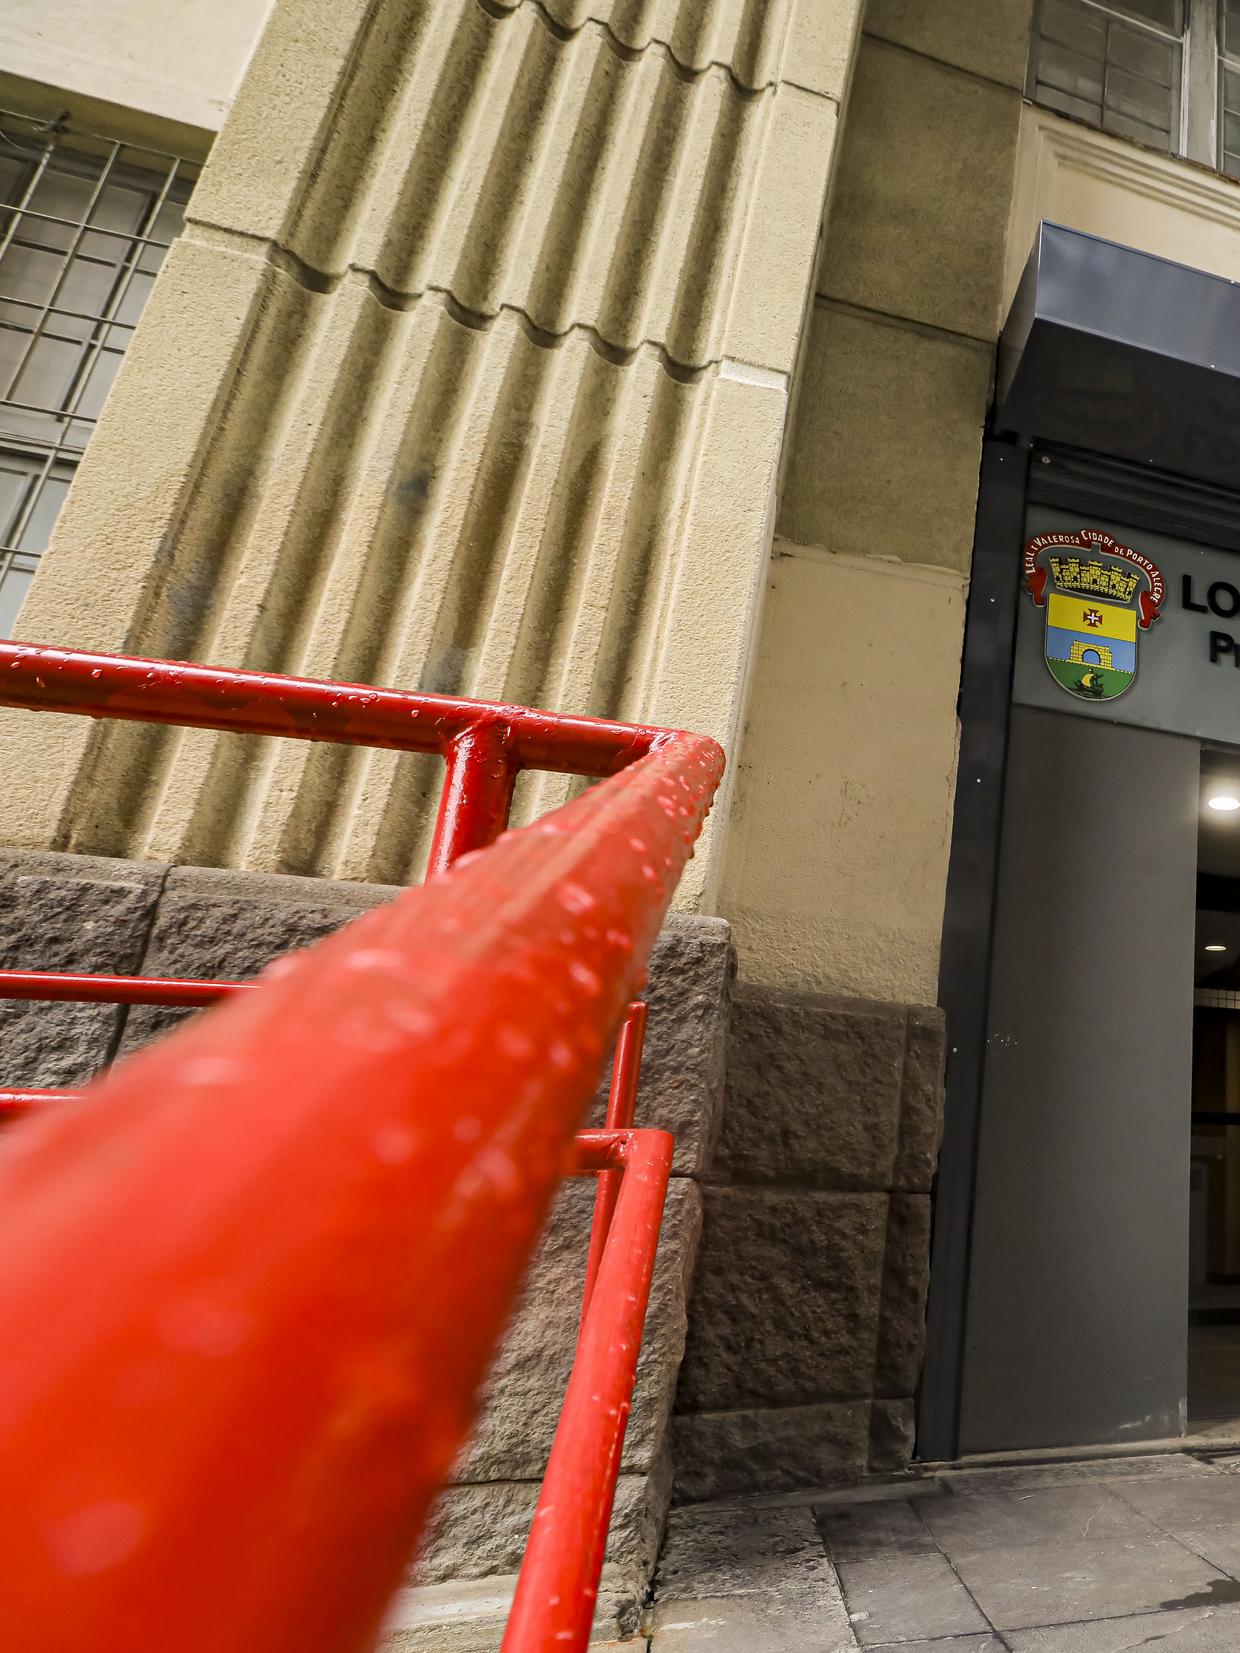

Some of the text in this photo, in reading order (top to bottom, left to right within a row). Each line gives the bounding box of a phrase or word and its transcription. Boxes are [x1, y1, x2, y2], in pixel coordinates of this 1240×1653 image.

[1033, 535, 1080, 547] VALEROSA
[1081, 530, 1114, 547] CIDADE
[1114, 546, 1124, 555] DE
[1126, 549, 1153, 571] PORTO
